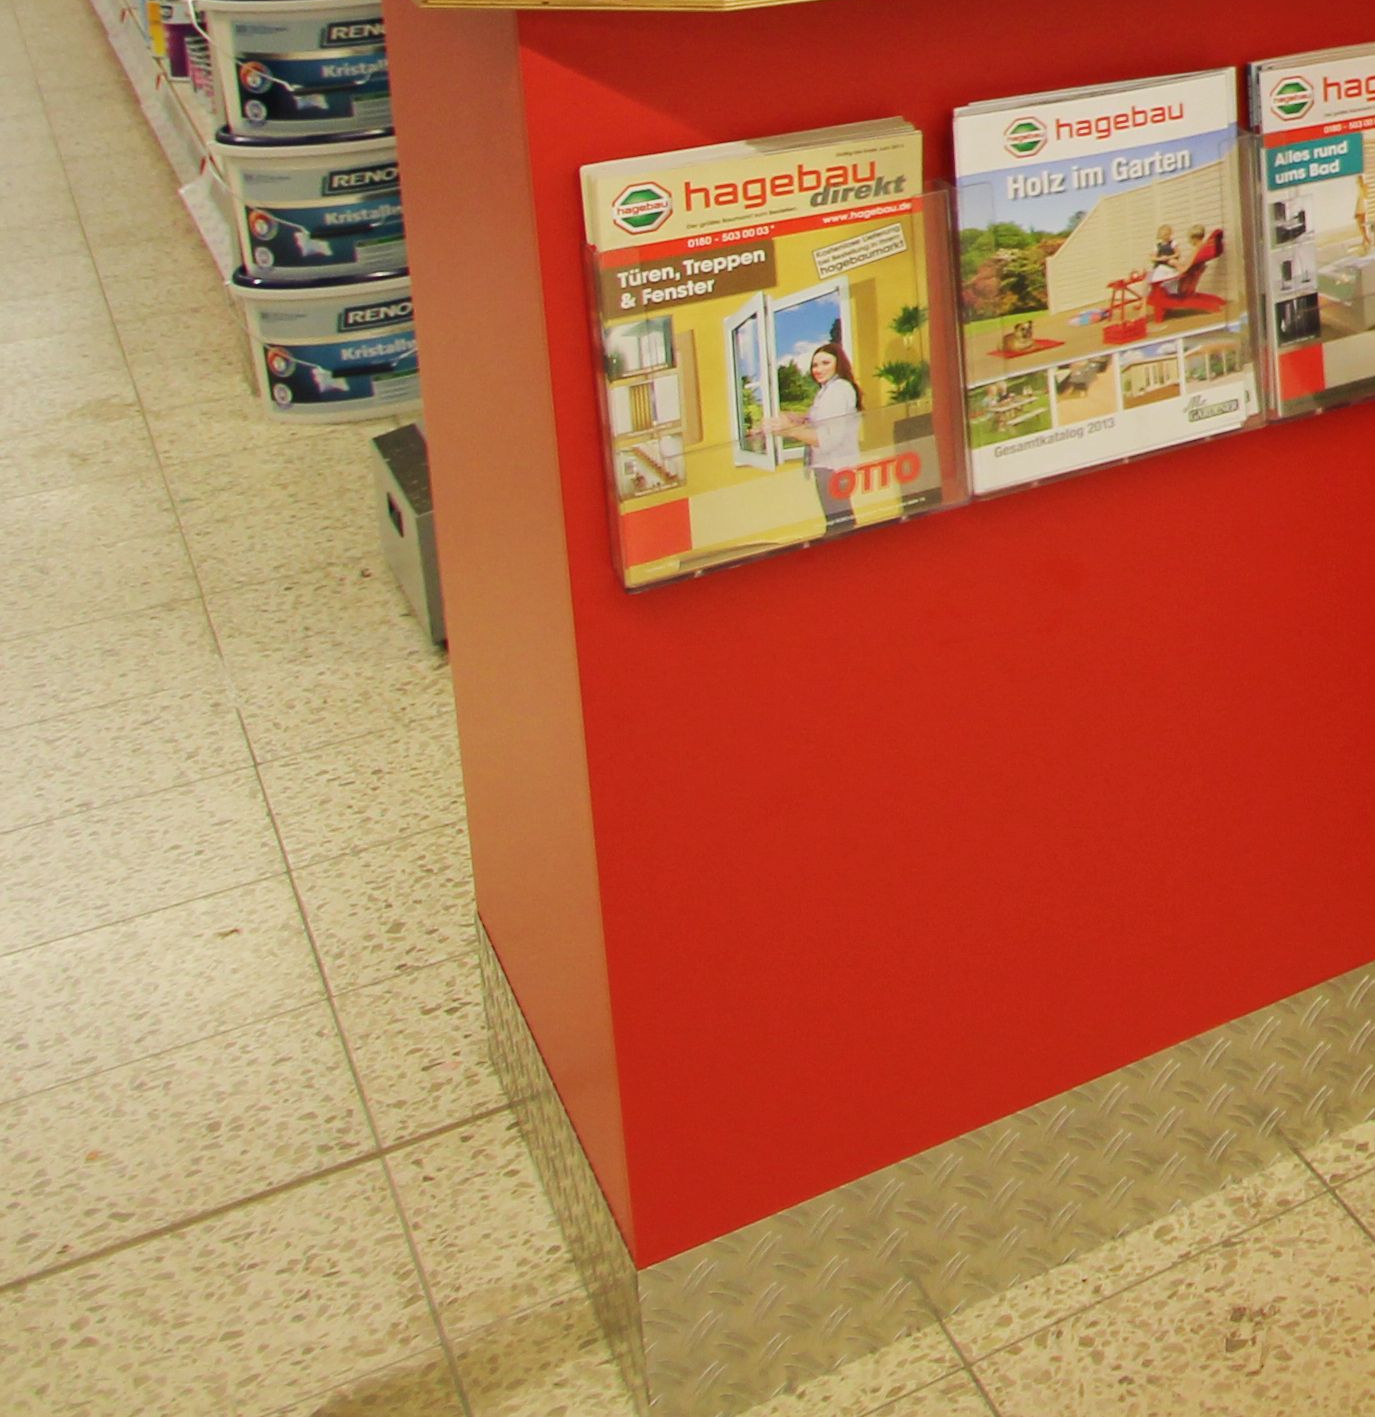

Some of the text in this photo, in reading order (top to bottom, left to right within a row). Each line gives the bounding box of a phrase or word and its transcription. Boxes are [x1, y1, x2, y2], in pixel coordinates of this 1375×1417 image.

[1054, 101, 1184, 142] hagebau
[1007, 146, 1192, 202] Holz im Garten
[1274, 140, 1348, 167] Alles rund
[1275, 159, 1340, 184] ums Bad
[684, 161, 907, 212] hagebau direkt
[615, 199, 670, 218] hagebau
[822, 202, 912, 225] www.hagebau.de
[616, 246, 766, 291] Türen, Treppen
[619, 277, 716, 311] & Fenster
[993, 416, 1116, 459] Gesamtkatalog 2013
[827, 451, 922, 501] OTTO
